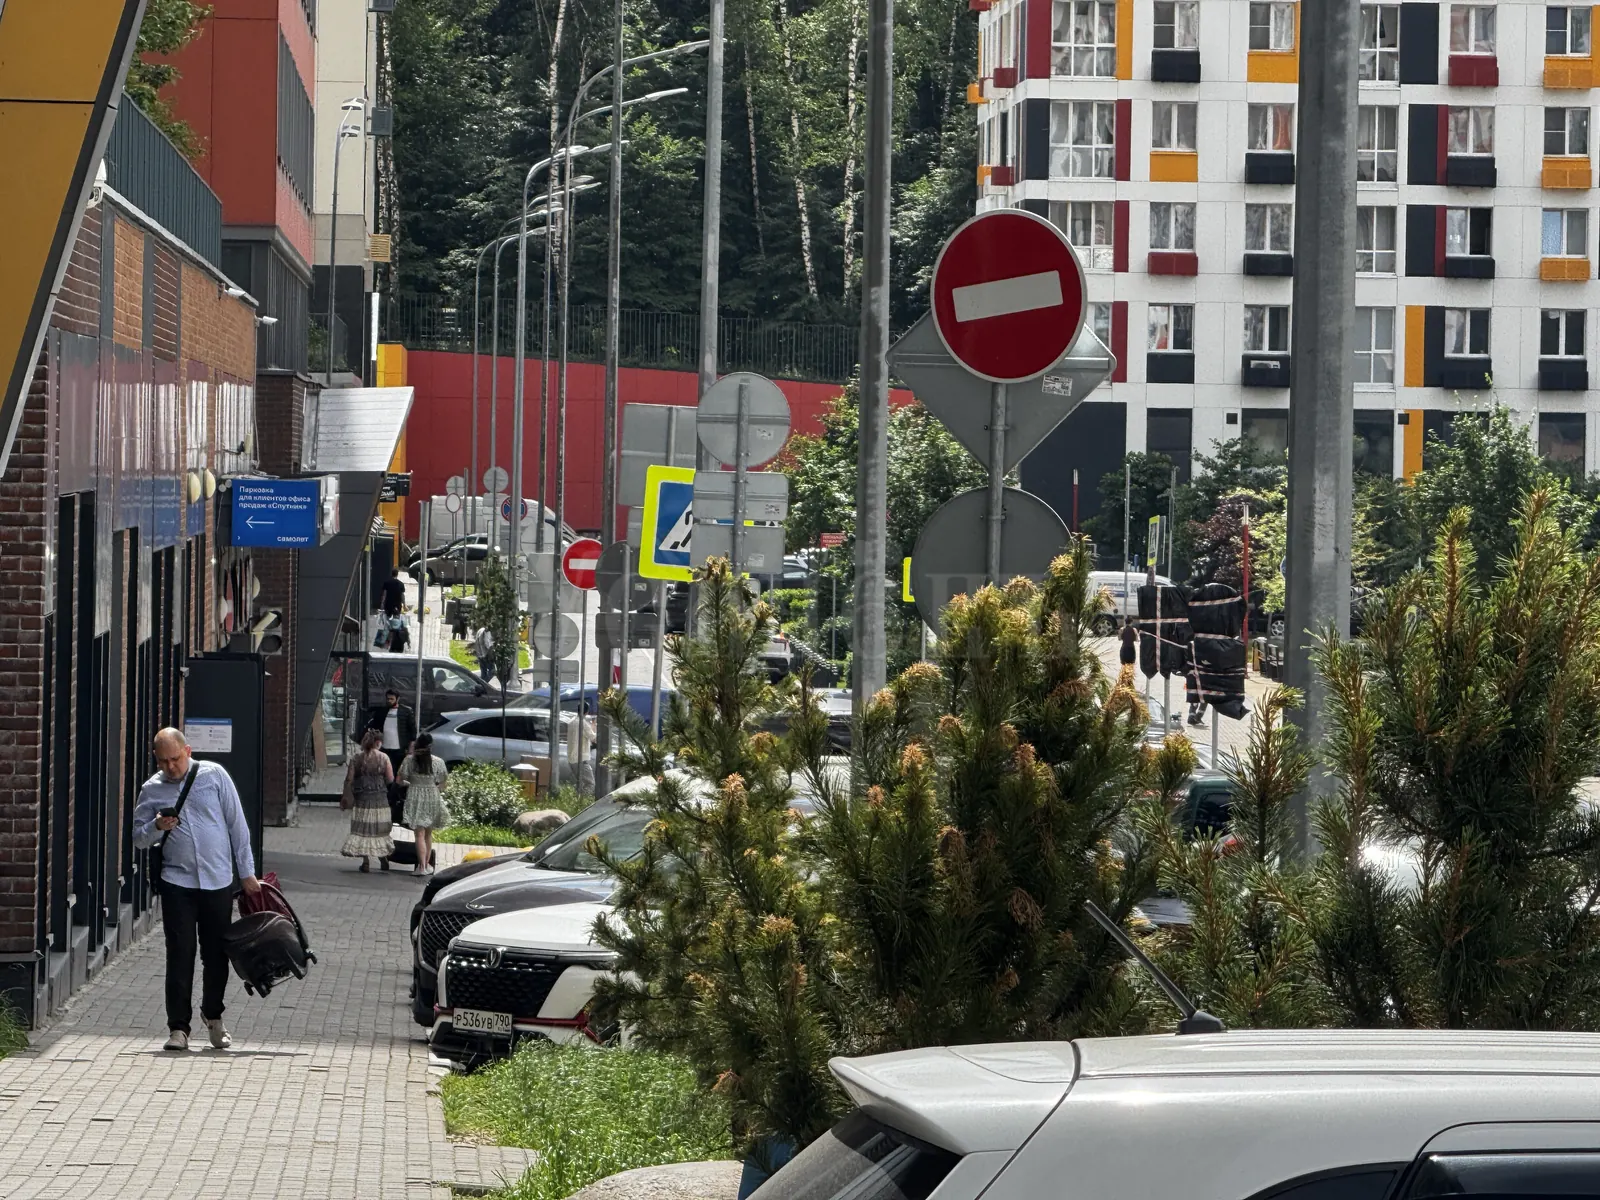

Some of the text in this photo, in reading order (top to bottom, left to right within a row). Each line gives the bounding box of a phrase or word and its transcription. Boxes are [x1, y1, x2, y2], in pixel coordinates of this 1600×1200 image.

[239, 485, 274, 494] Парковка
[268, 502, 307, 511] «Спутник»
[495, 1013, 510, 1027] 790
